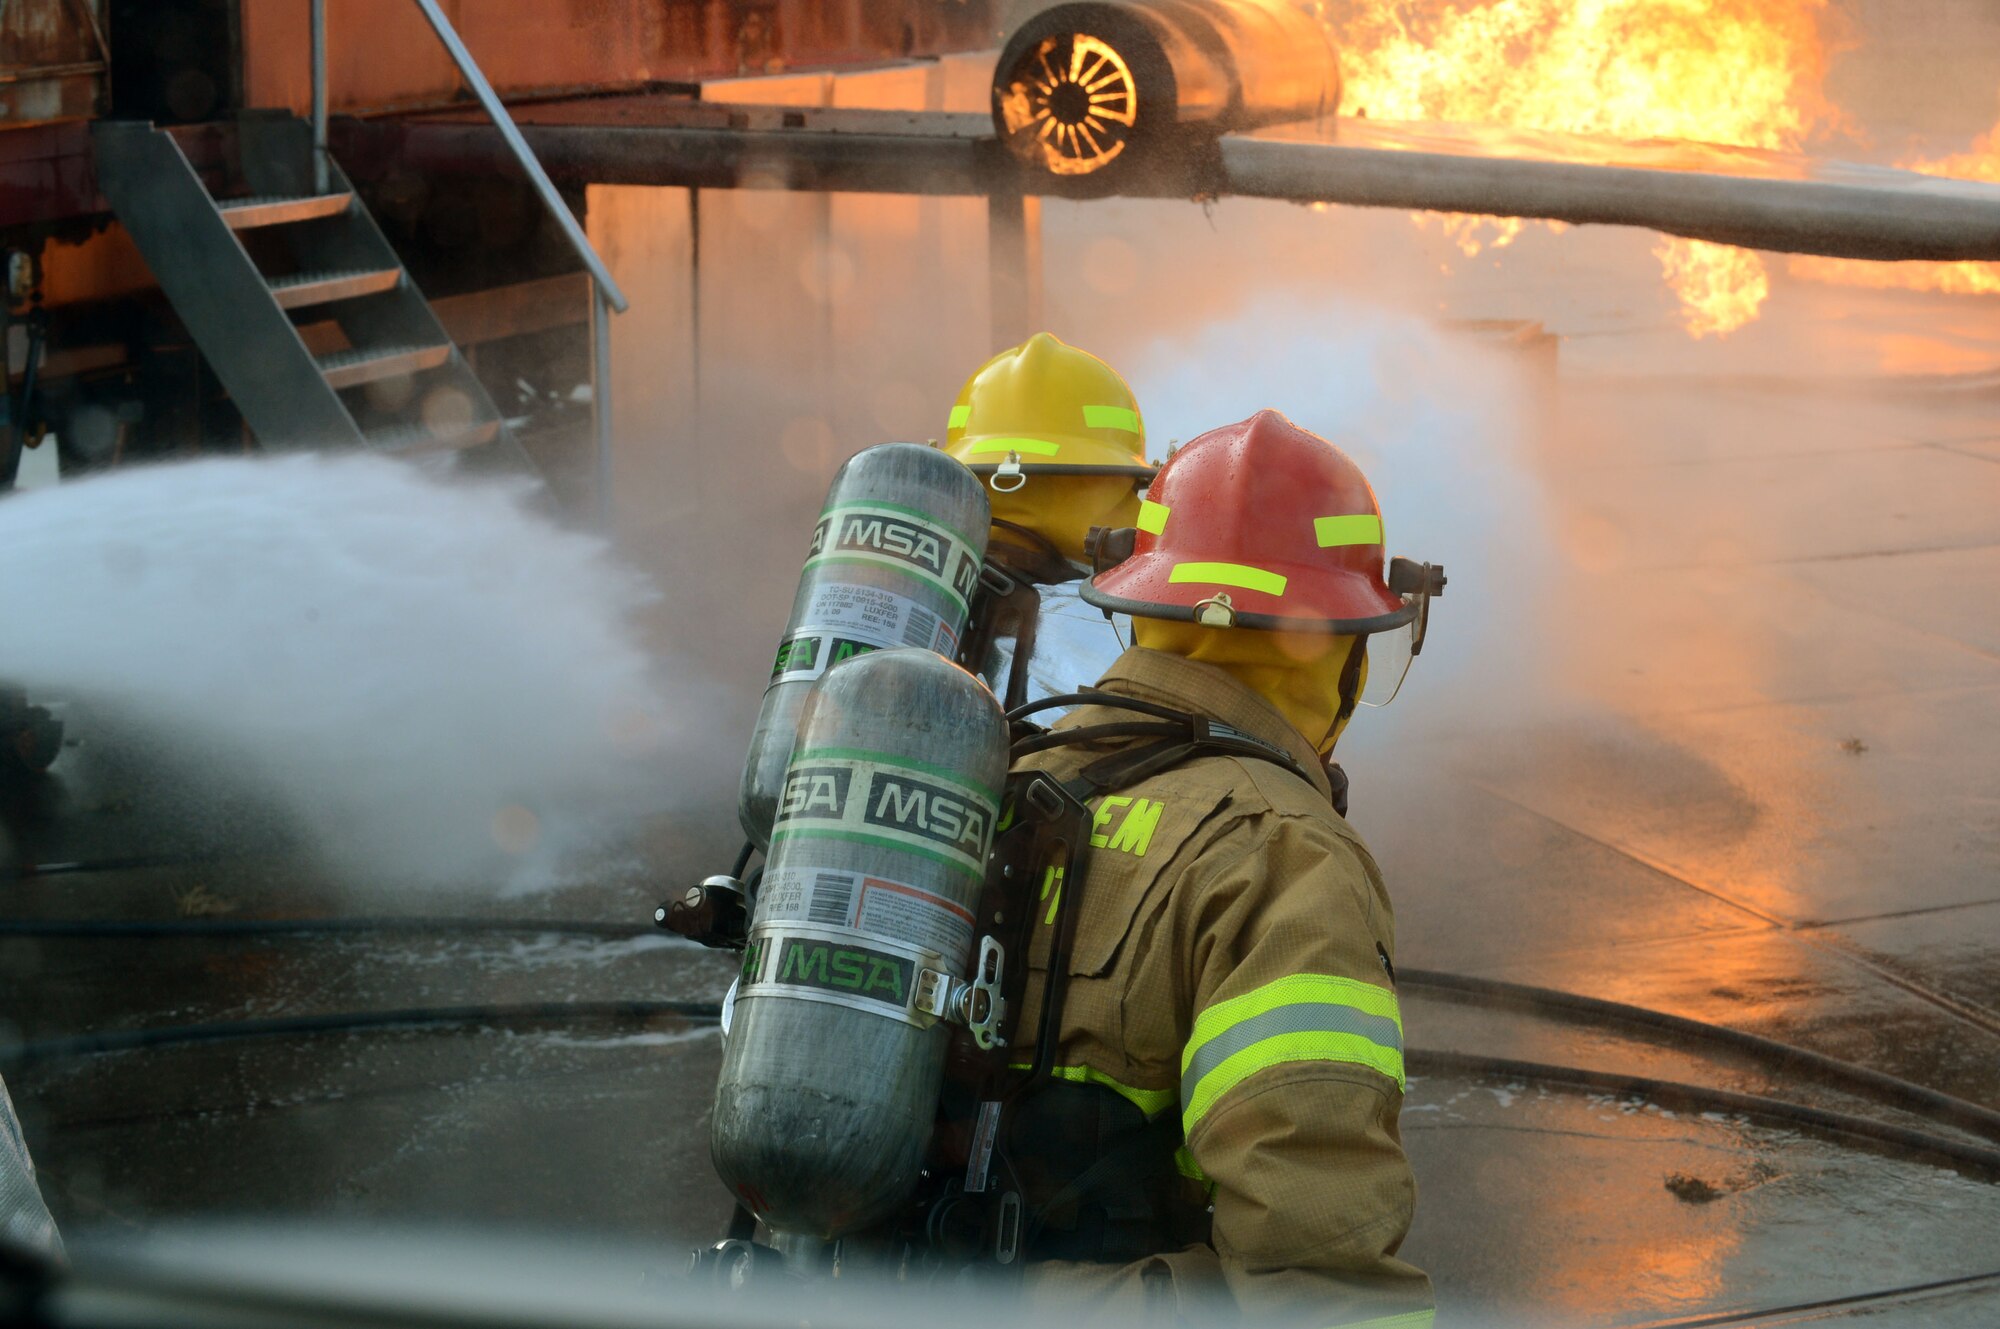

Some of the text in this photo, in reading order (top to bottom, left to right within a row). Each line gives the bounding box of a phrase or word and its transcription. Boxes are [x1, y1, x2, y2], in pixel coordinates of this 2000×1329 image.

[843, 519, 942, 570] MSA
[820, 593, 850, 601] DOT-SP
[863, 605, 899, 621] LUXFER
[875, 782, 985, 856] MSA
[1084, 796, 1165, 857] EM
[781, 944, 903, 1001] MSA
